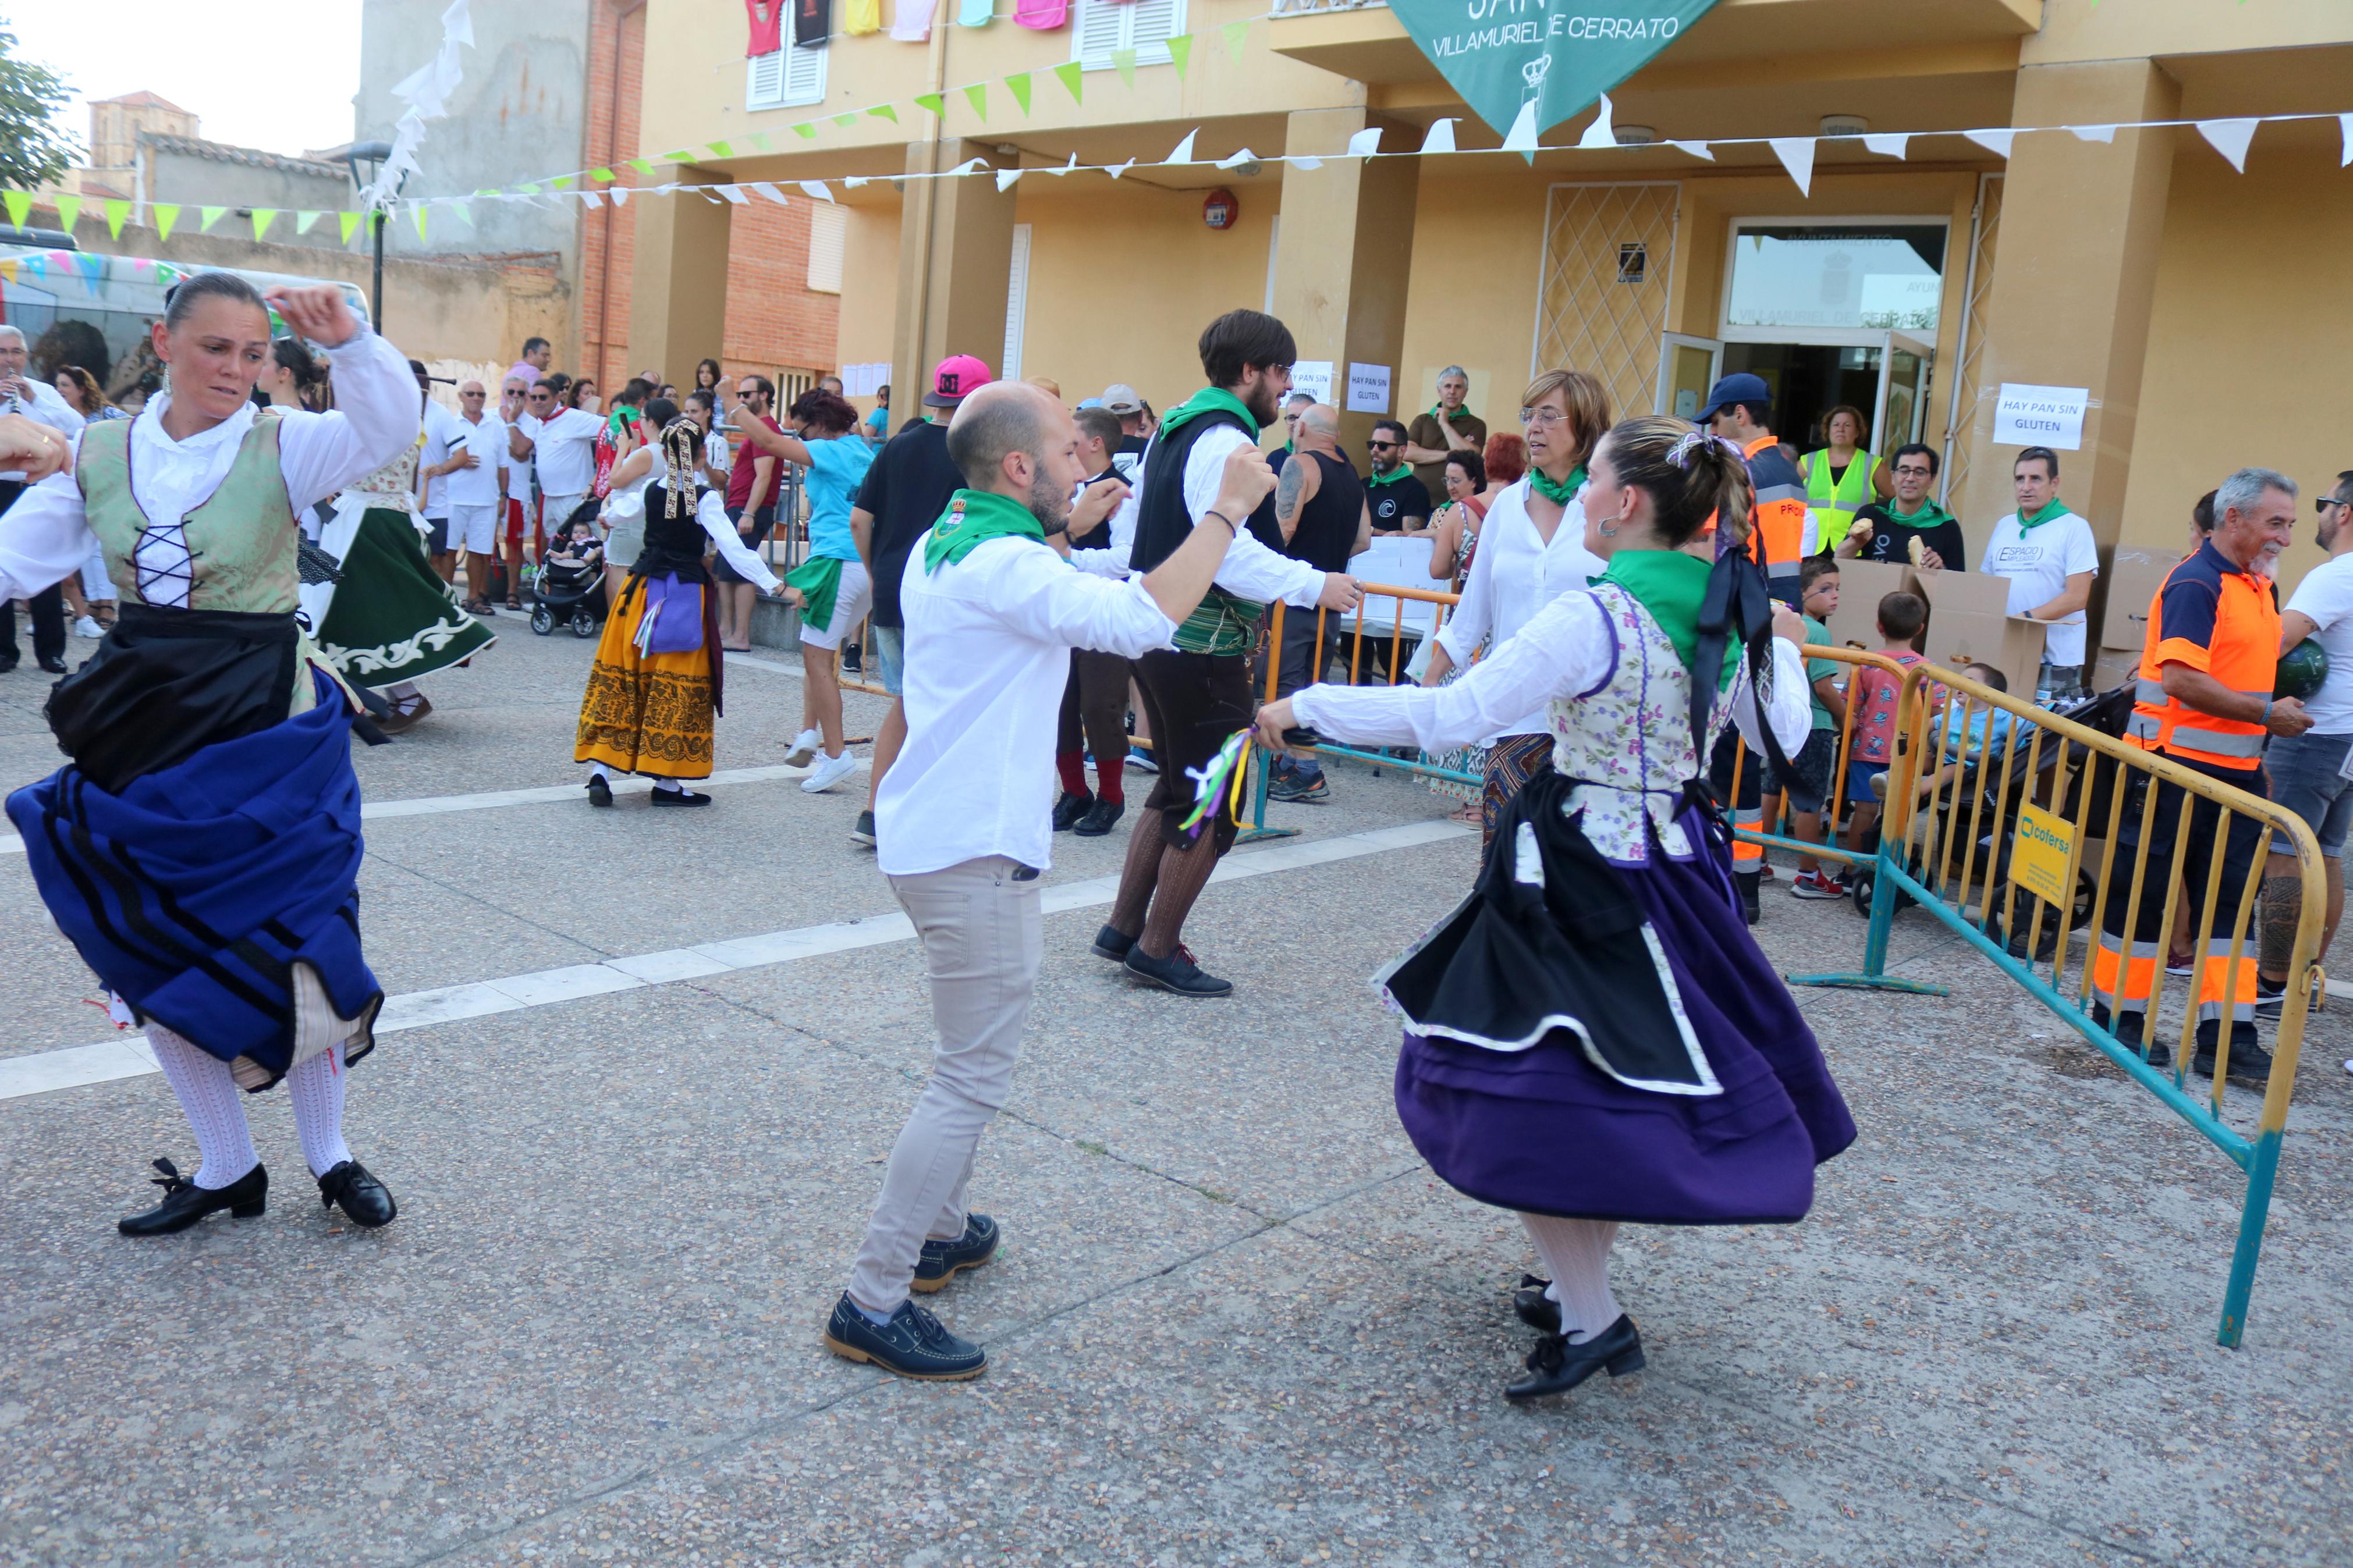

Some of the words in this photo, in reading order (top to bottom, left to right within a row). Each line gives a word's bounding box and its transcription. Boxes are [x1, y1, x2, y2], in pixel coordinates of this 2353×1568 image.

[1433, 22, 1544, 57] VILLAMURIEL
[1568, 16, 1678, 39] CERRATO
[1784, 234, 1891, 247] AYUNTAMIENTO
[1739, 308, 1825, 323] VILLAMURIEL
[1834, 311, 1852, 322] DE
[1298, 374, 1314, 382] PAN
[1352, 376, 1364, 384] HAY
[1357, 391, 1379, 400] GLUTEN
[2004, 401, 2028, 411] HAY
[2031, 403, 2056, 414] PAN
[2058, 405, 2078, 414] SIN
[2015, 419, 2061, 431] GLUTEN
[1873, 534, 1890, 560] VO
[2034, 826, 2069, 855] cofersa
